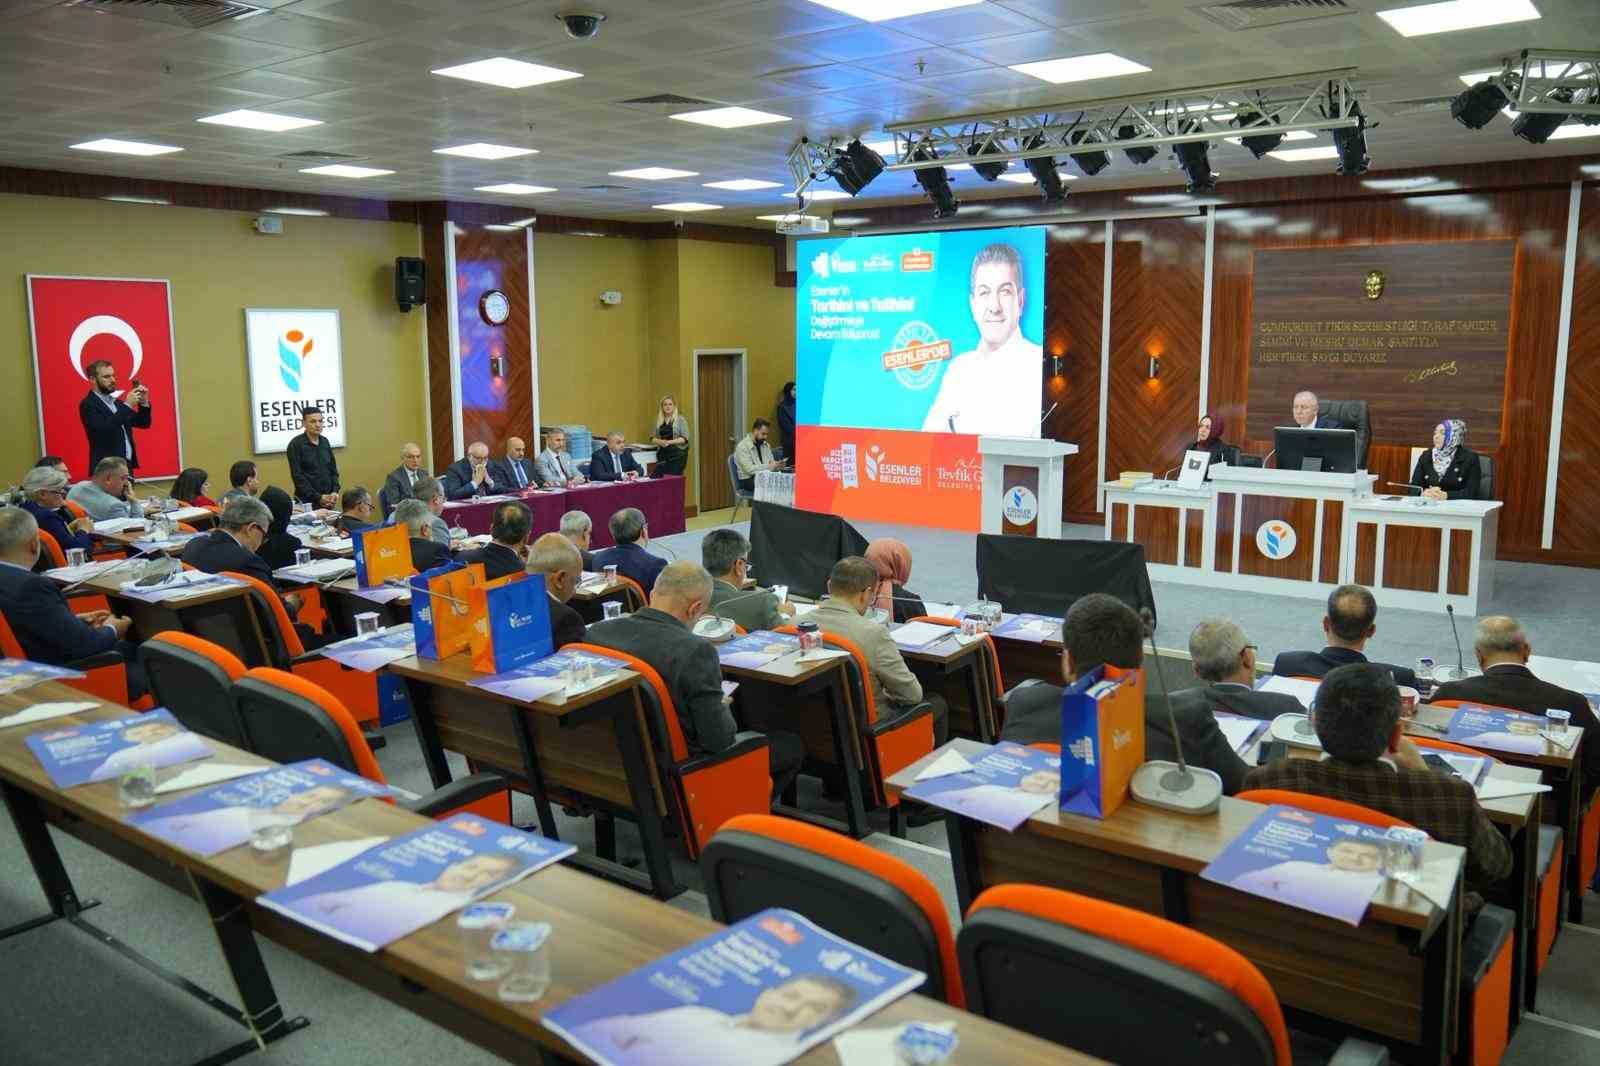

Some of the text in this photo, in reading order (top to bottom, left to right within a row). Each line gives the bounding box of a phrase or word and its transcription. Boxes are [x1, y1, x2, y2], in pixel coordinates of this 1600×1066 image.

[880, 464, 921, 477] ESENLER
[936, 467, 970, 482] Tevfik
[880, 474, 921, 486] BELEDİYESİ
